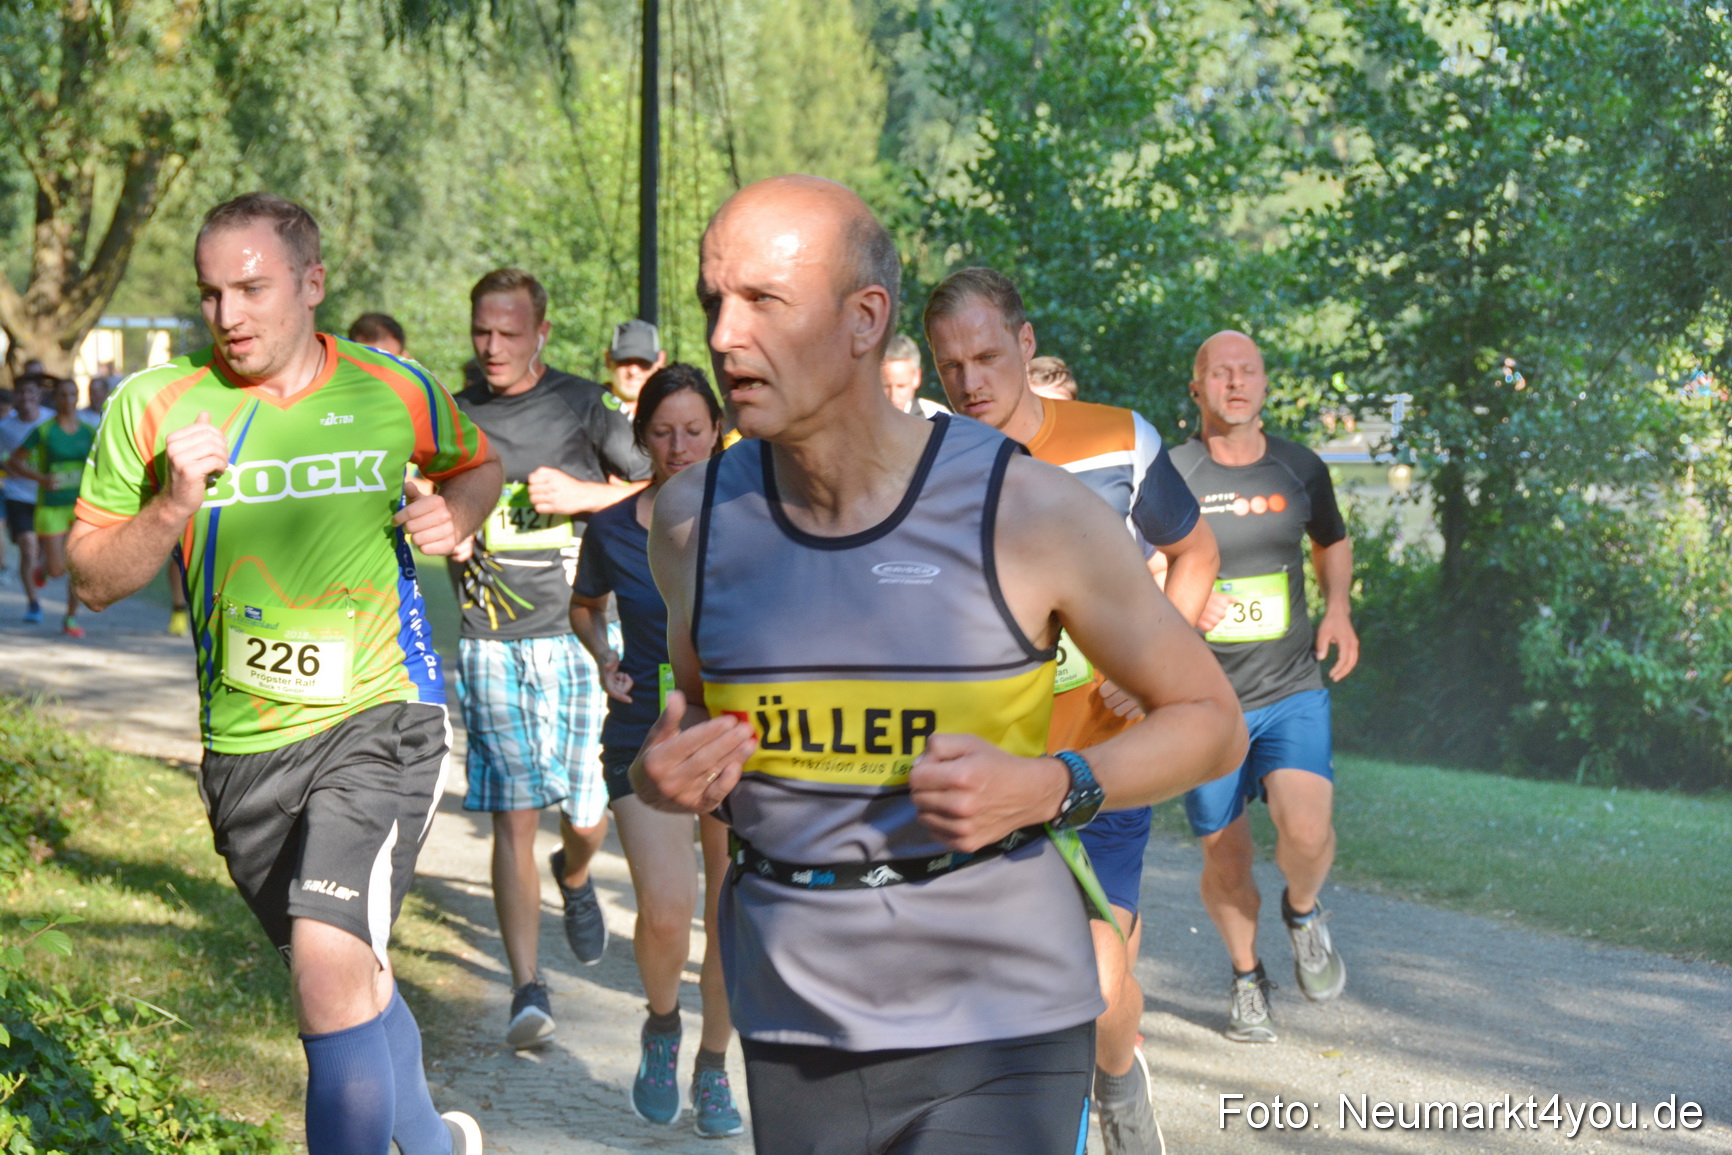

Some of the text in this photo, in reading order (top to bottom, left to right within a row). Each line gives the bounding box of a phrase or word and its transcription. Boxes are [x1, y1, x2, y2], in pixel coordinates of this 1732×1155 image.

[201, 450, 388, 508] BOCK
[1232, 601, 1263, 623] 36
[245, 637, 321, 677] 226
[295, 678, 316, 687] Ralf
[720, 695, 936, 755] ÜLLER
[860, 762, 886, 774] aus
